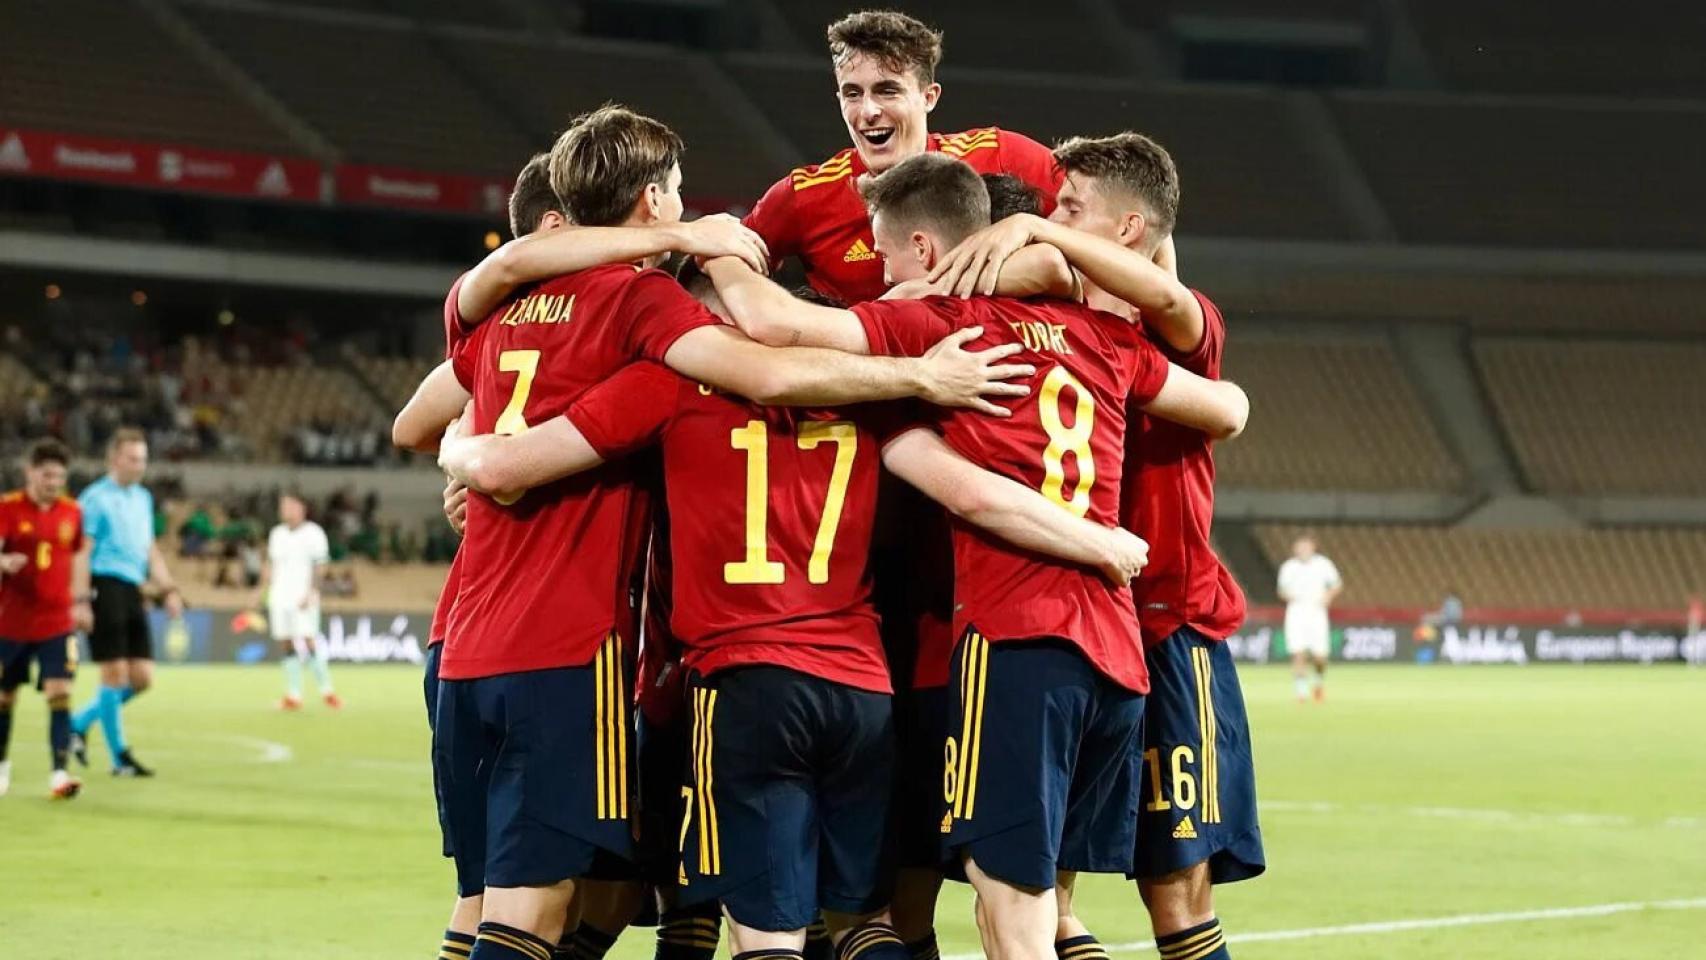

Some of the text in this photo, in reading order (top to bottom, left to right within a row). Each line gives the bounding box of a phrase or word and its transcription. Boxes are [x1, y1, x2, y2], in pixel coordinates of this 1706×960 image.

[1038, 365, 1096, 518] 8
[723, 420, 858, 585] 17
[944, 736, 957, 804] 8
[1143, 745, 1197, 811] 16
